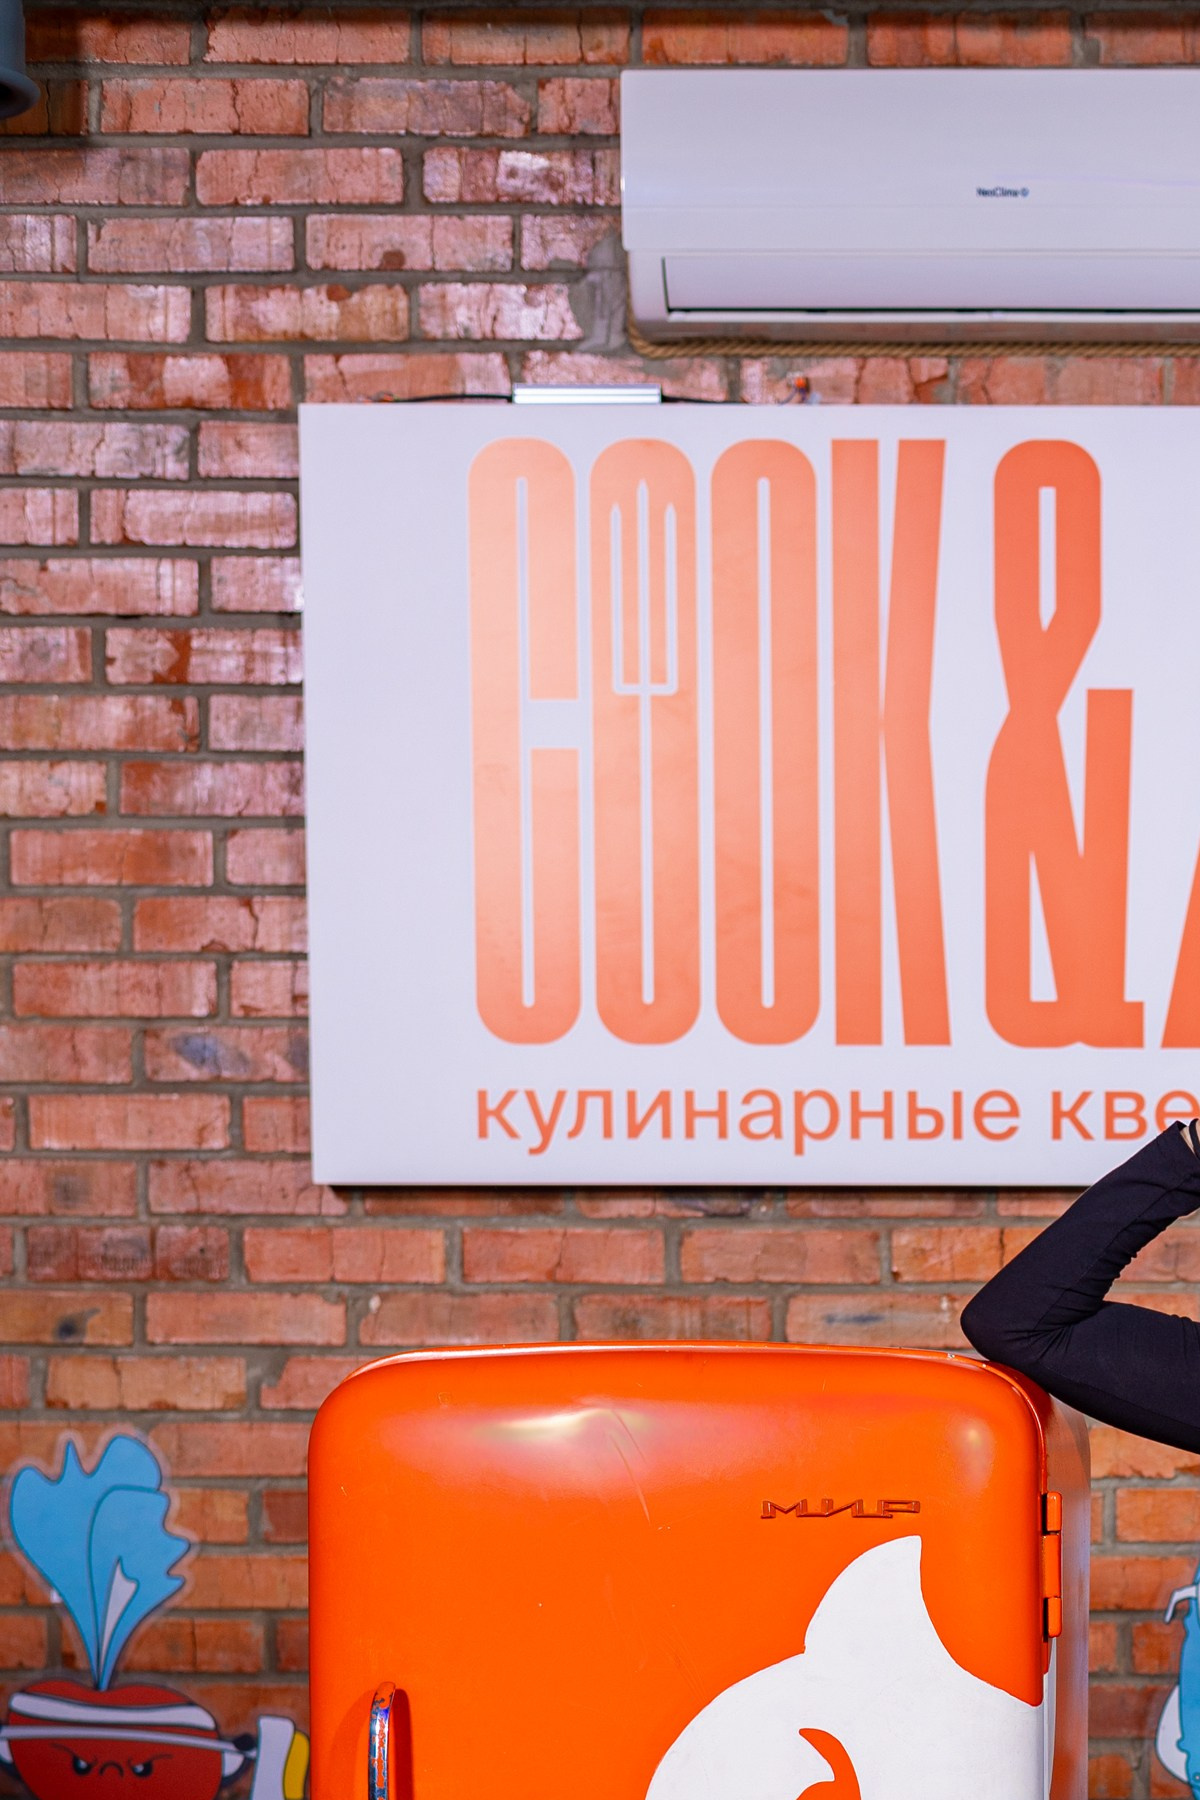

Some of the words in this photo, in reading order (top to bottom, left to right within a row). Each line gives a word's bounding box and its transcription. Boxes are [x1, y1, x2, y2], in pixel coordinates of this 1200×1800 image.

[468, 437, 951, 1046] COOK
[985, 439, 1144, 1048] &
[476, 1087, 1021, 1157] кулинарные
[761, 1499, 920, 1518] МИР
